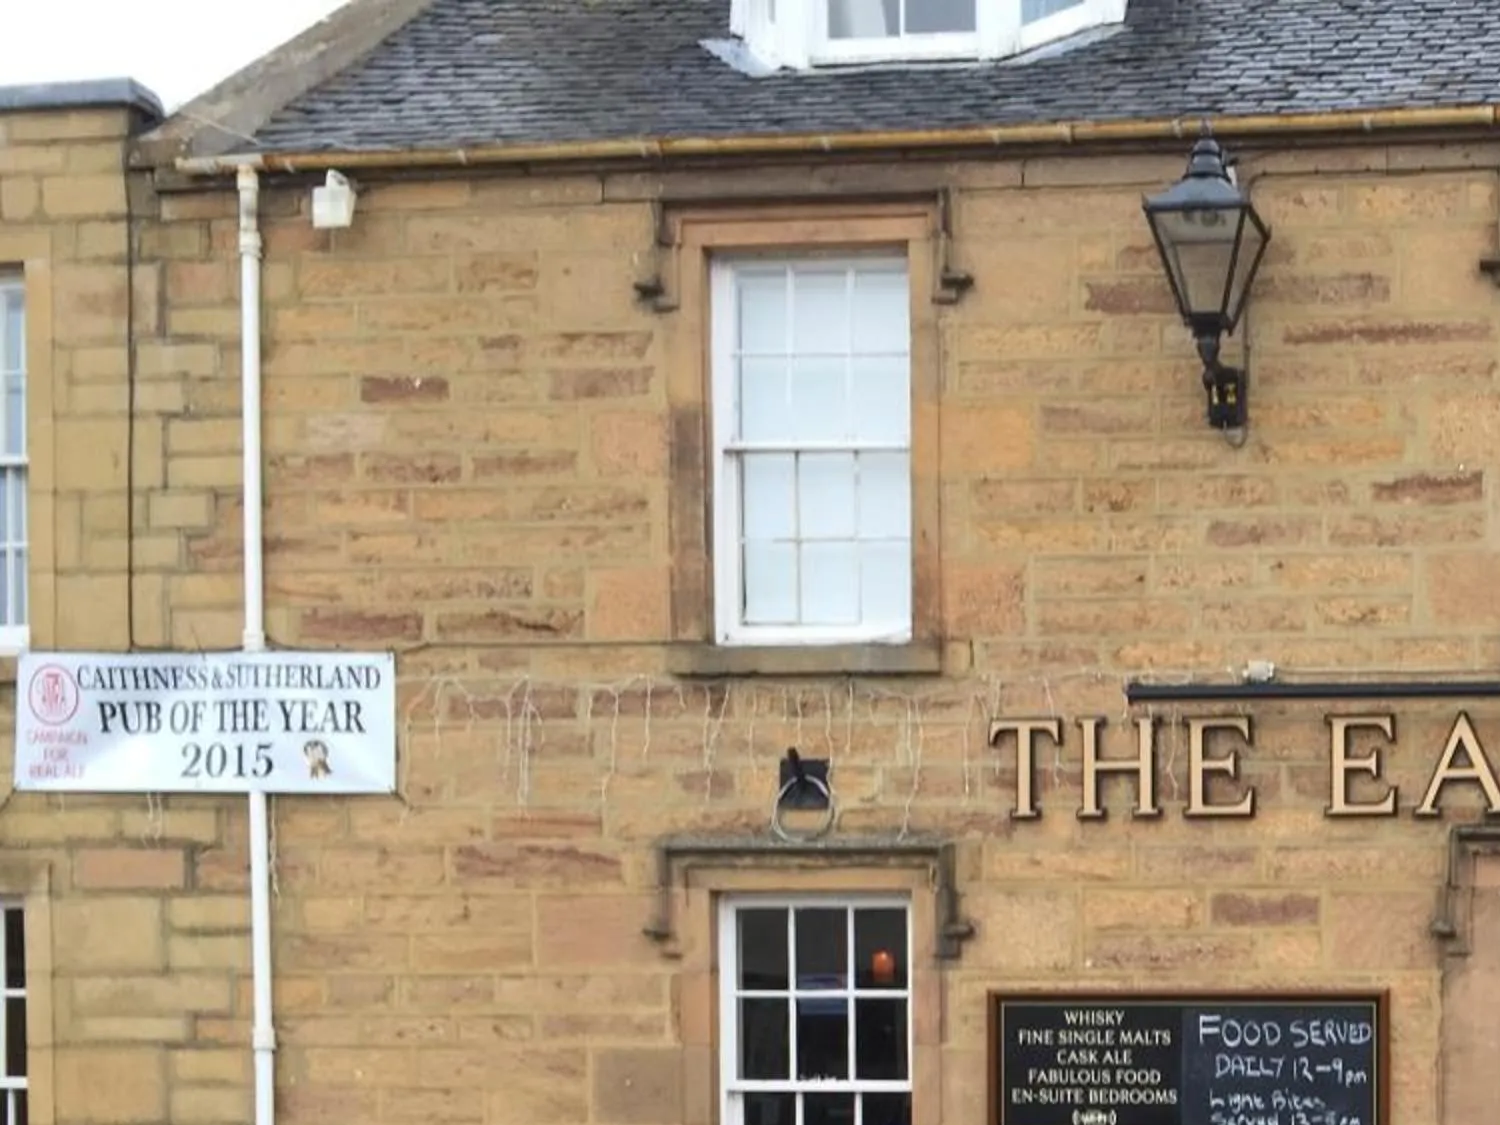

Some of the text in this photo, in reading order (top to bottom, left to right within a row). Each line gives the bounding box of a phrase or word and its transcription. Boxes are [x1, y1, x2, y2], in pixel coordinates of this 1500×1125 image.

[76, 664, 209, 690] CAITHNESS
[226, 663, 381, 690] SUTHERLAND
[98, 699, 366, 734] PUB OF THE YEAR
[181, 741, 274, 779] 2015
[988, 716, 1255, 820] THE
[1064, 1010, 1125, 1025] WHISKY
[1199, 1014, 1372, 1048] FOOD SERVED
[1018, 1029, 1171, 1046] FINE SINGLE MALTS
[1057, 1049, 1132, 1065] CASK ALE
[1215, 1052, 1285, 1079] DAILY
[1028, 1069, 1161, 1085] FABULOUS FOOD
[1011, 1088, 1178, 1105] EN-SUITE BEDROOMS
